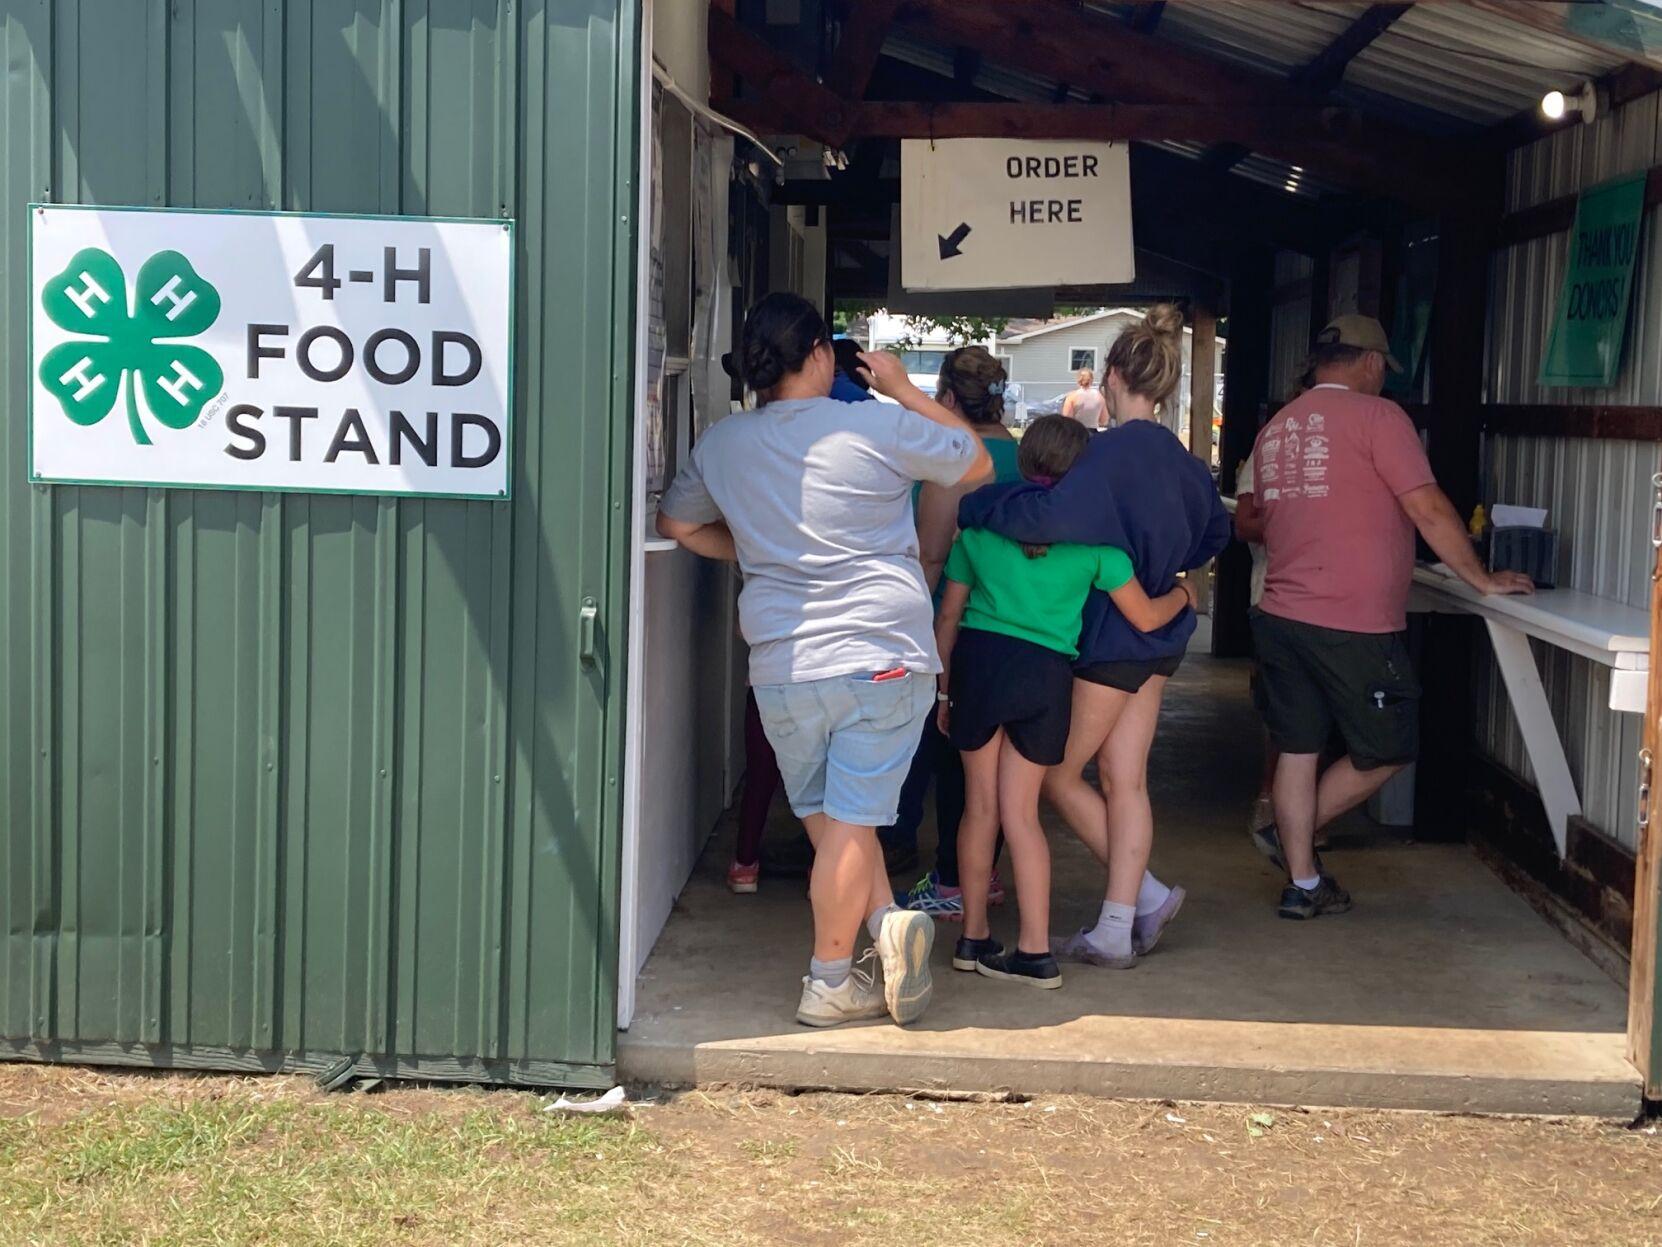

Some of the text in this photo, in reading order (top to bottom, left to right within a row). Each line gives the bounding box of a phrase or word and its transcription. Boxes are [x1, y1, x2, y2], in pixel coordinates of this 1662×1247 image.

[1006, 154, 1099, 179] ORDER
[1009, 200, 1083, 224] HERE
[1577, 222, 1635, 270] THANK YOU
[63, 270, 197, 322] H H
[293, 243, 431, 304] 4-H
[246, 323, 483, 387] FOOD
[59, 356, 203, 407] H H
[223, 403, 502, 469] STAND
